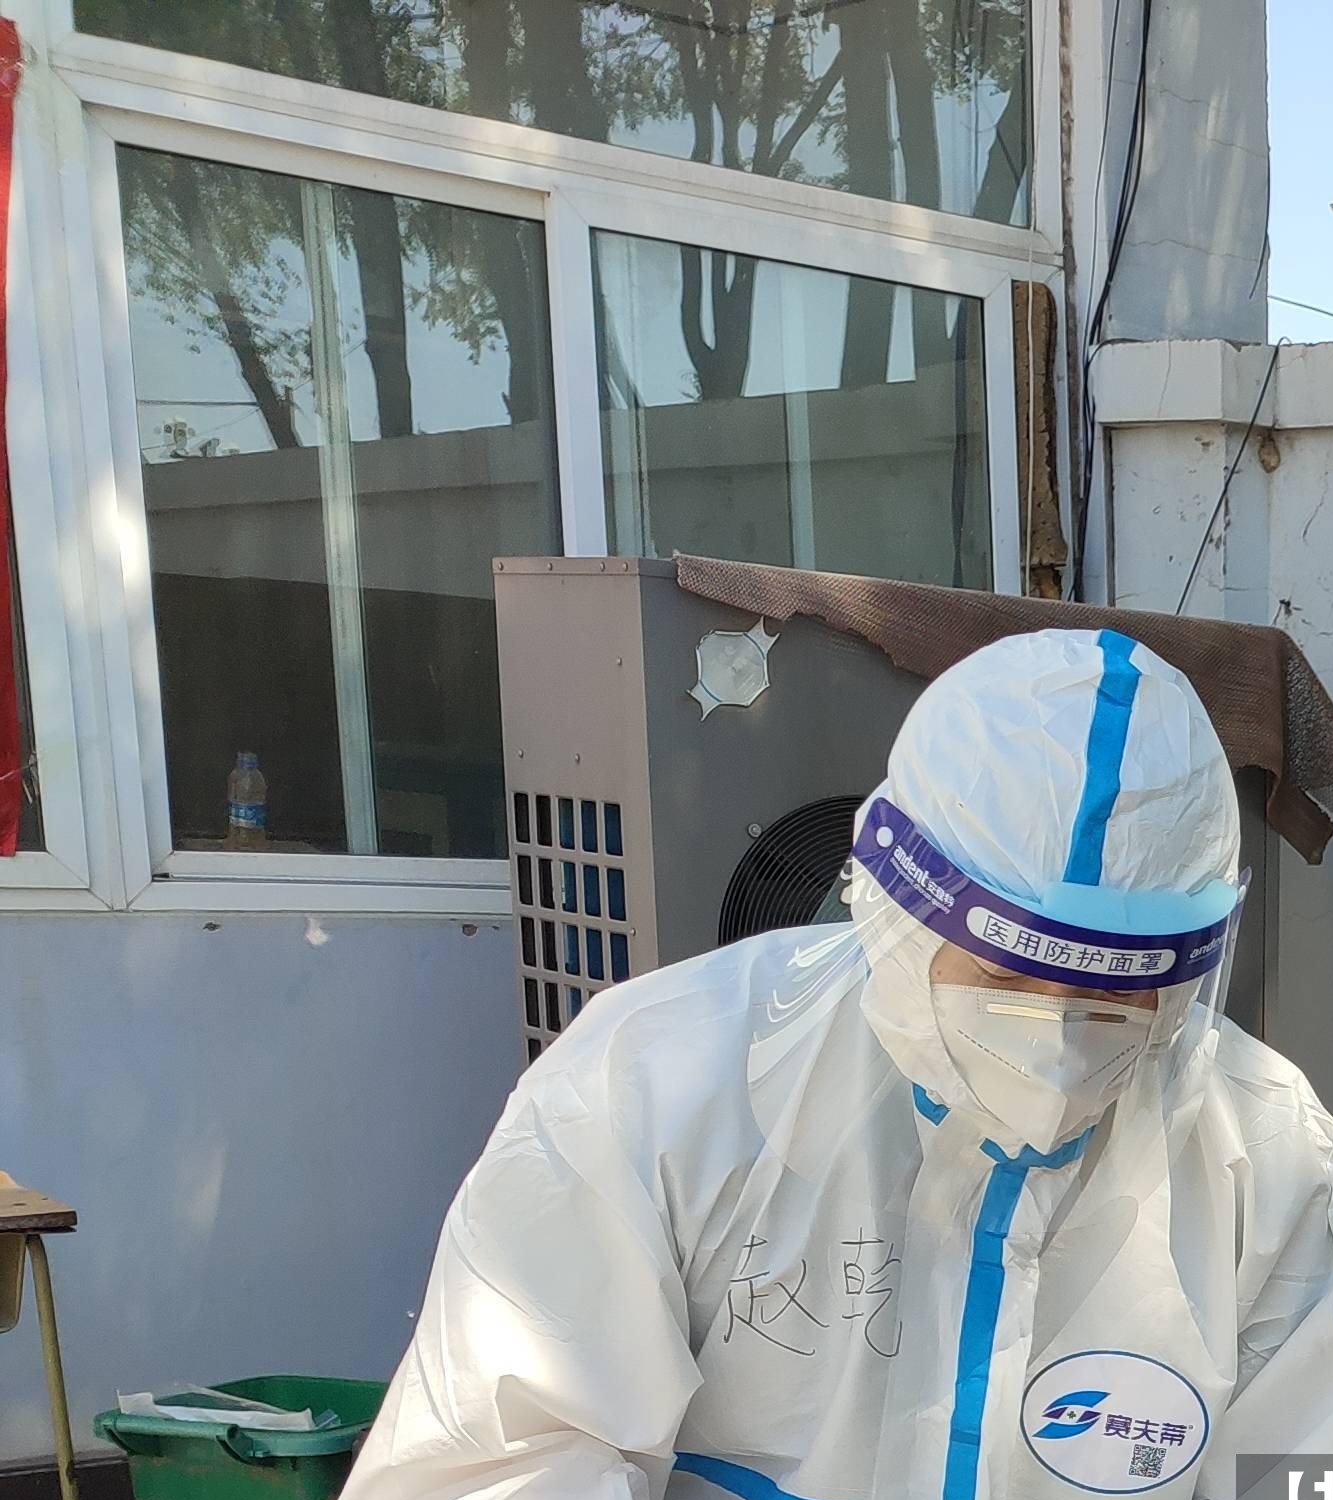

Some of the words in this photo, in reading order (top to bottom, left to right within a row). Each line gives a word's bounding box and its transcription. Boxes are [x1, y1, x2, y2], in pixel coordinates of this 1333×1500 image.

[893, 845, 929, 887] andent
[983, 914, 1163, 976] 医用防护面罩
[723, 1226, 903, 1358] 赵乾
[1103, 1413, 1189, 1447] 赛夫蒂
